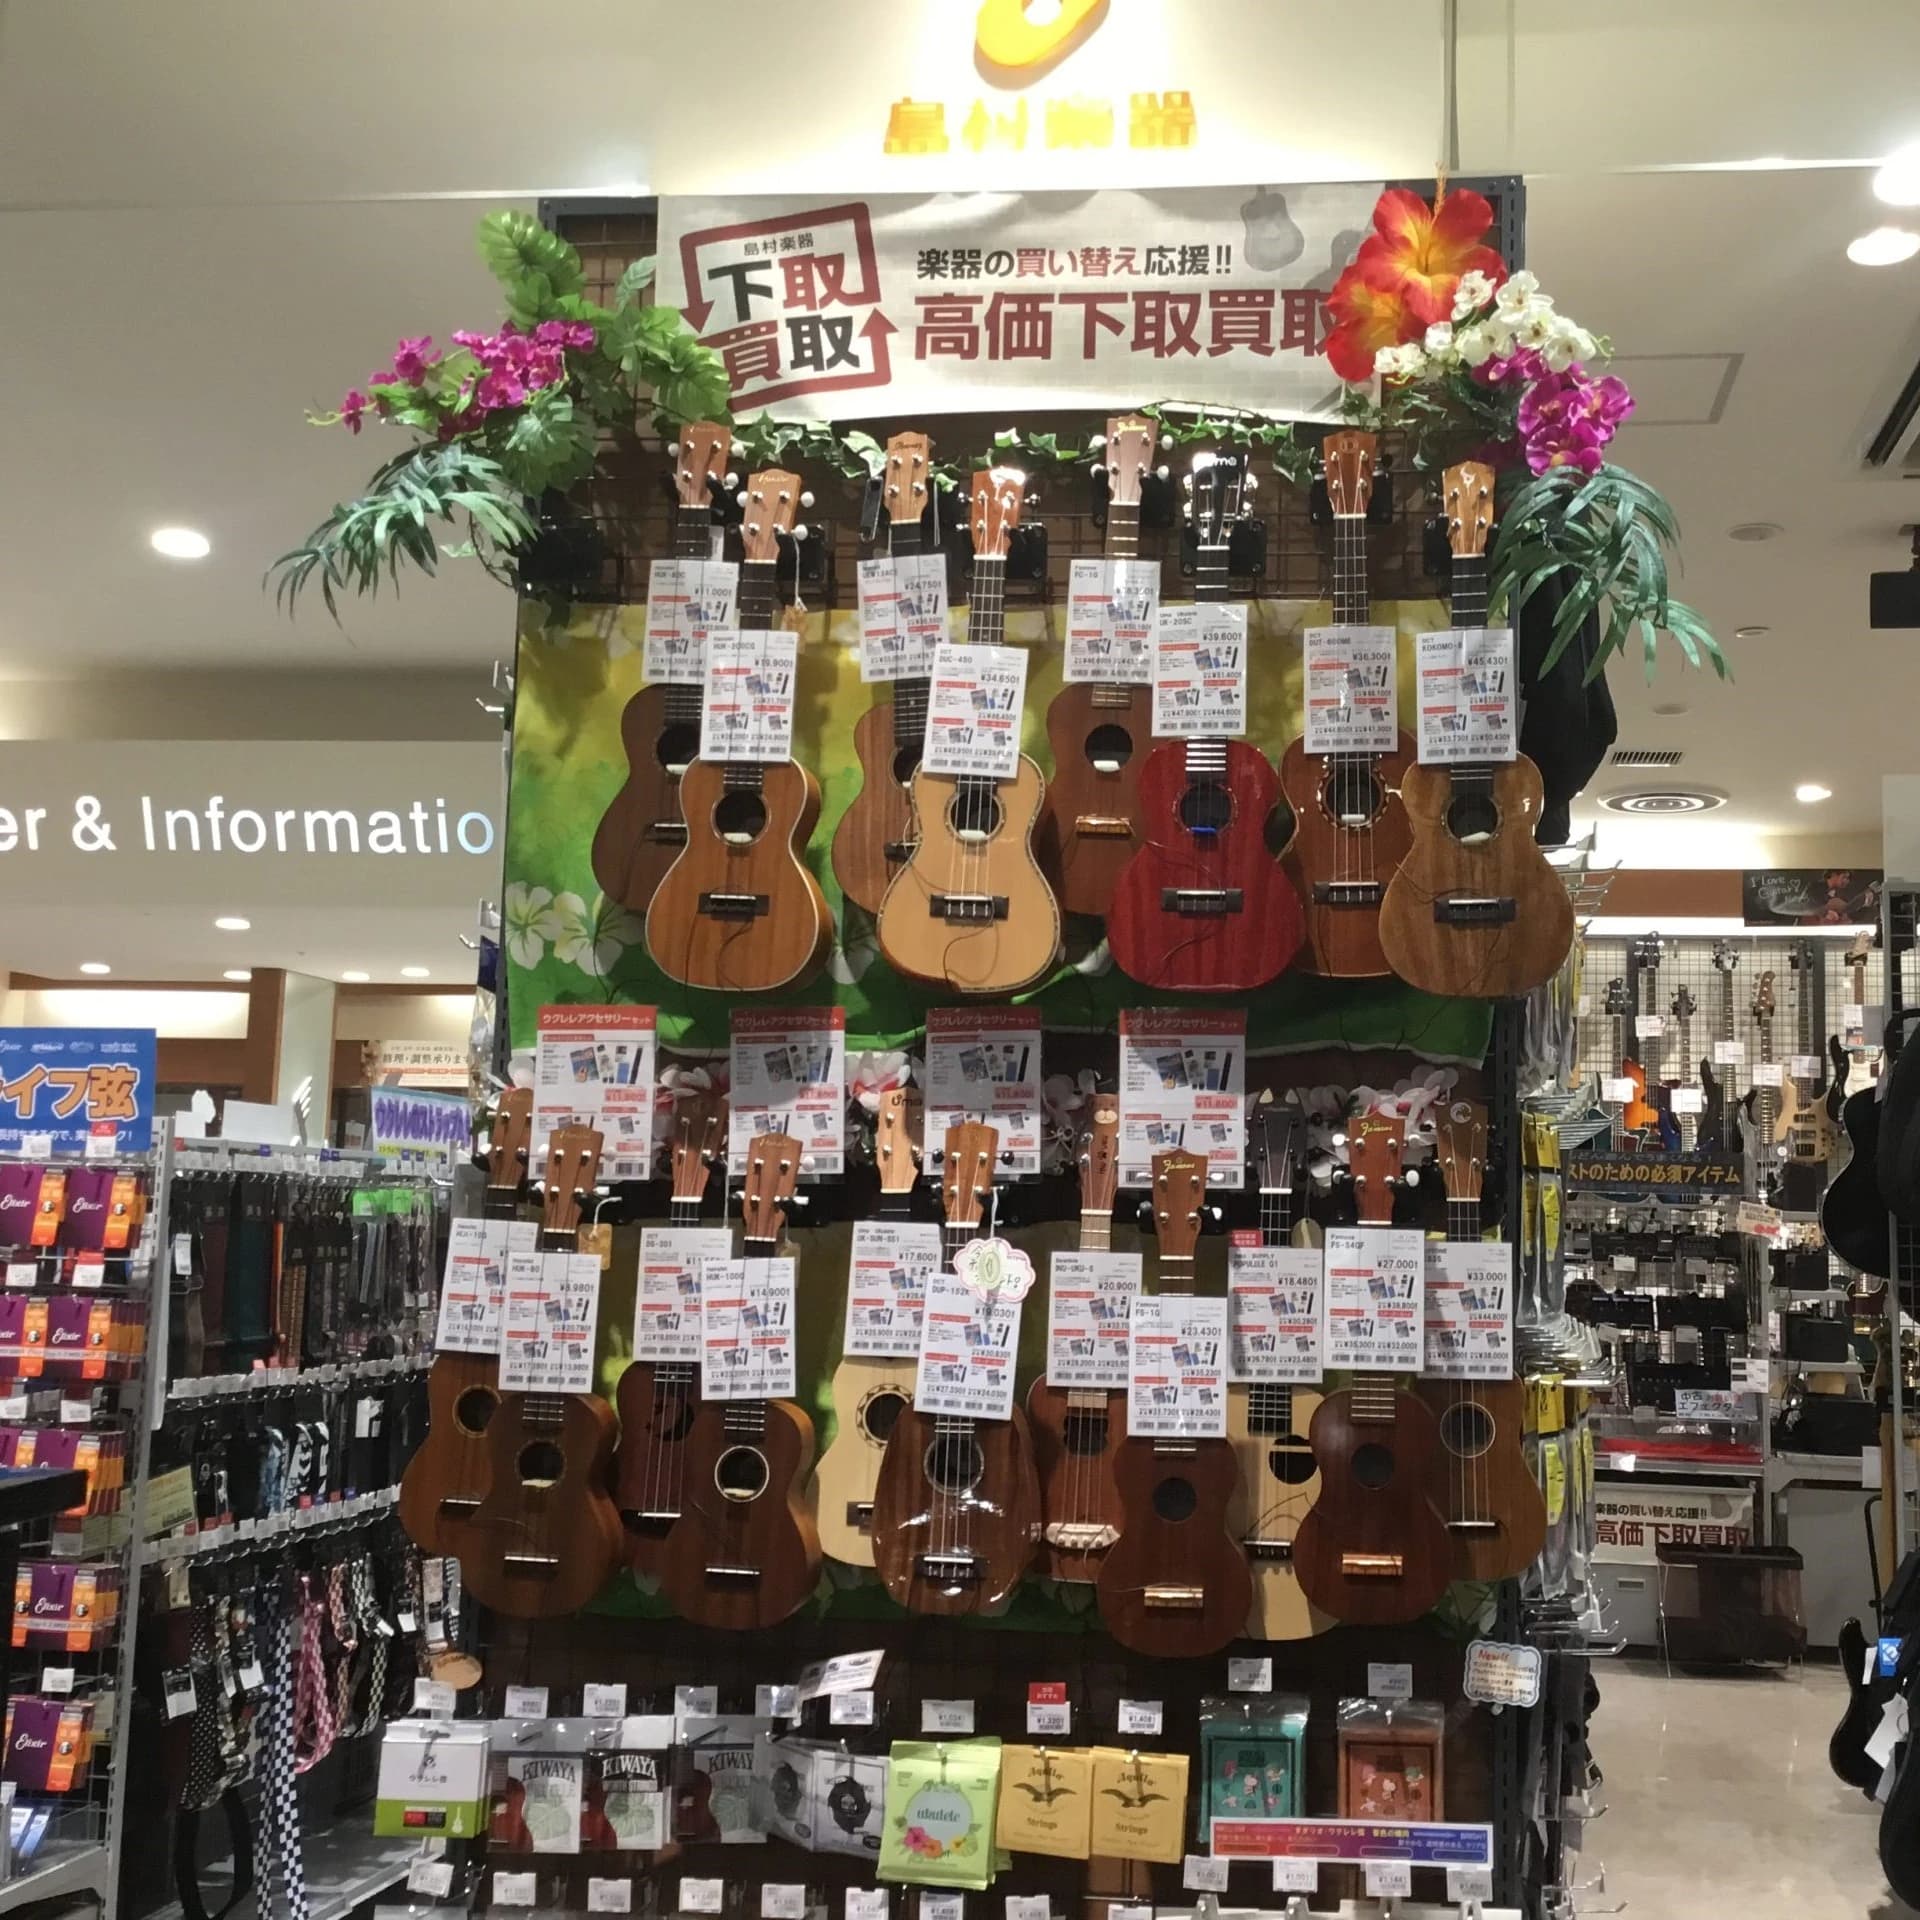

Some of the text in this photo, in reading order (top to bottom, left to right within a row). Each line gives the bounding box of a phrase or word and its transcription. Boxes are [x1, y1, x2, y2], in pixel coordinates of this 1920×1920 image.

[744, 232, 814, 257] 島村楽器
[708, 252, 846, 322] 下取
[913, 289, 1335, 361] 高価下取買取
[717, 313, 860, 391] 買取
[72, 796, 117, 851] &
[141, 796, 494, 854] Informatio
[0, 1064, 140, 1121] イフ弦
[1360, 1121, 1393, 1136] Famous
[1163, 1158, 1196, 1174] Famous
[72, 1197, 104, 1213] Elixir
[52, 1328, 82, 1345] Elixir
[34, 1597, 65, 1613] Elixir
[15, 1733, 47, 1750] Elixir
[522, 1760, 576, 1781] KIWAYA
[602, 1754, 657, 1780] KIWAYA
[1028, 1765, 1064, 1781] Aquila
[1116, 1771, 1157, 1786] Aquila
[916, 1806, 961, 1823] ukulele
[1026, 1816, 1058, 1830] Strings
[1115, 1821, 1149, 1836] Strings
